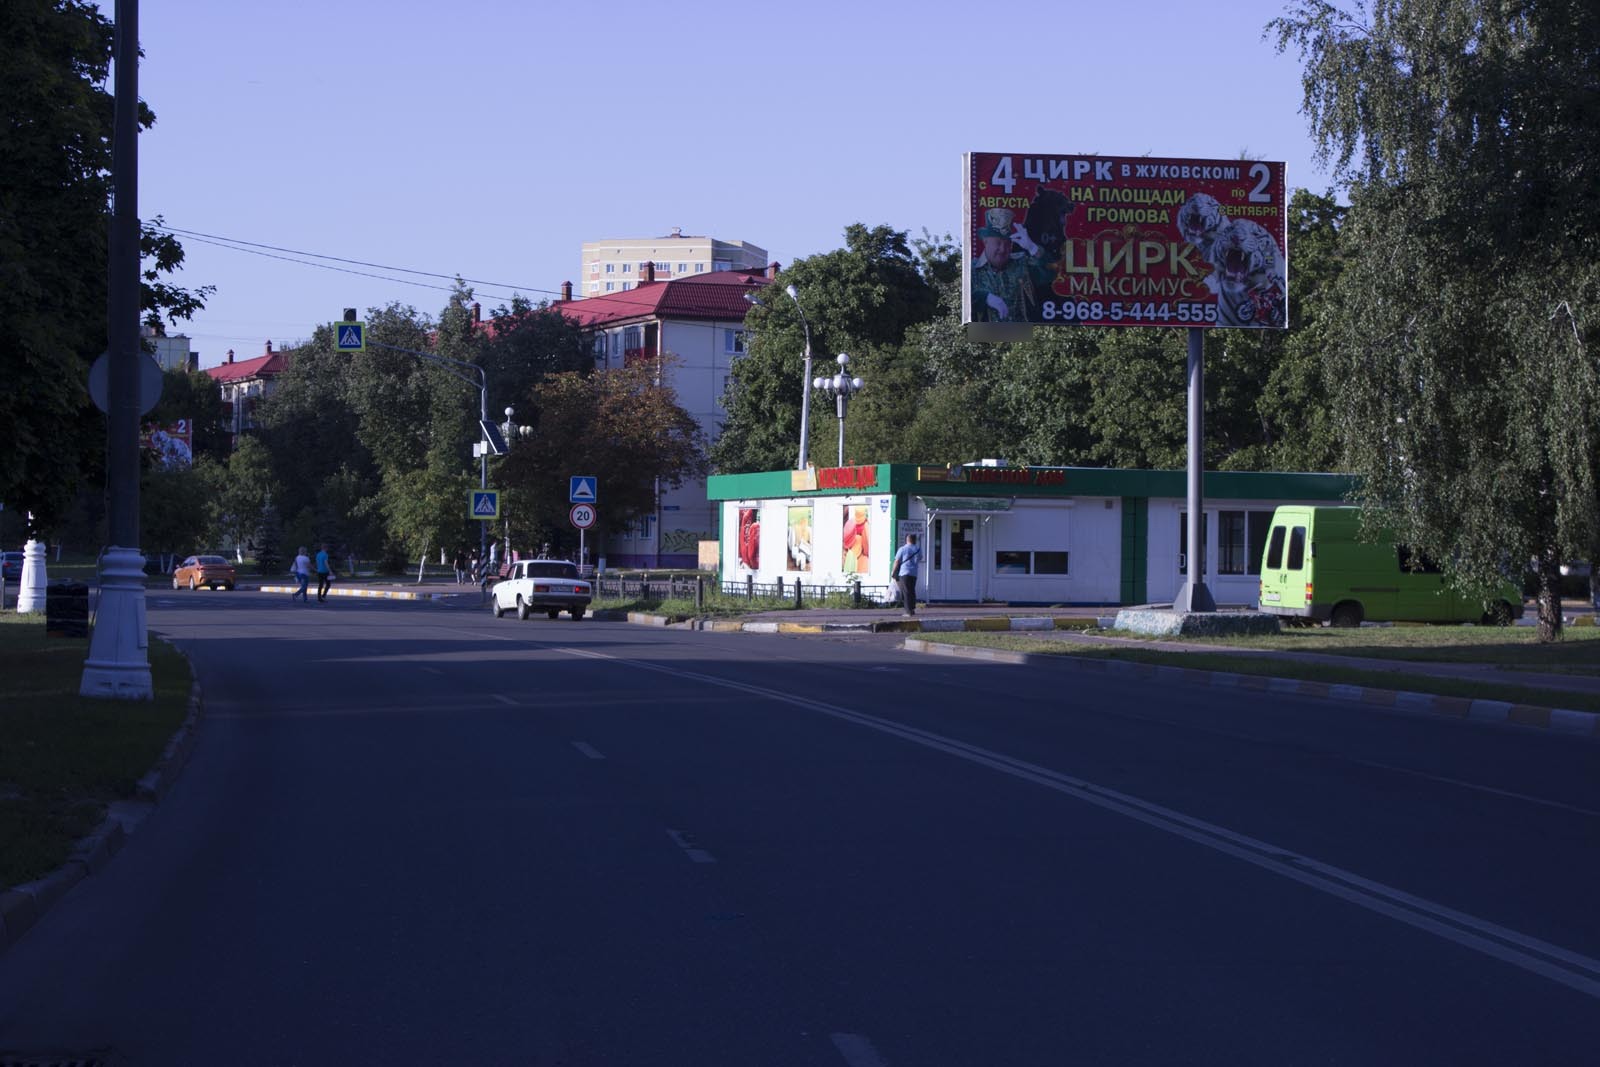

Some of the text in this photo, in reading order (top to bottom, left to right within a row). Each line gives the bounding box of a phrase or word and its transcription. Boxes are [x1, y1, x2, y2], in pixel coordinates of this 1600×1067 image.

[991, 156, 1017, 195] 4
[1023, 158, 1113, 183] ЦИРК
[1135, 163, 1241, 181] ЖУКОВСКОМ!
[1248, 163, 1272, 204] 2
[978, 196, 1031, 209] АВГУСТА
[1070, 186, 1186, 206] НА ПЛОЩАДИ
[1087, 207, 1170, 224] ГРОМОВА
[1219, 205, 1279, 217] СЕНТЯБРЯ
[1065, 239, 1199, 279] ЦИРК
[1069, 276, 1193, 297] МАКСИМУС
[1041, 301, 1218, 322] 8-968-5-444-555
[177, 419, 186, 433] 2
[577, 510, 590, 521] 20
